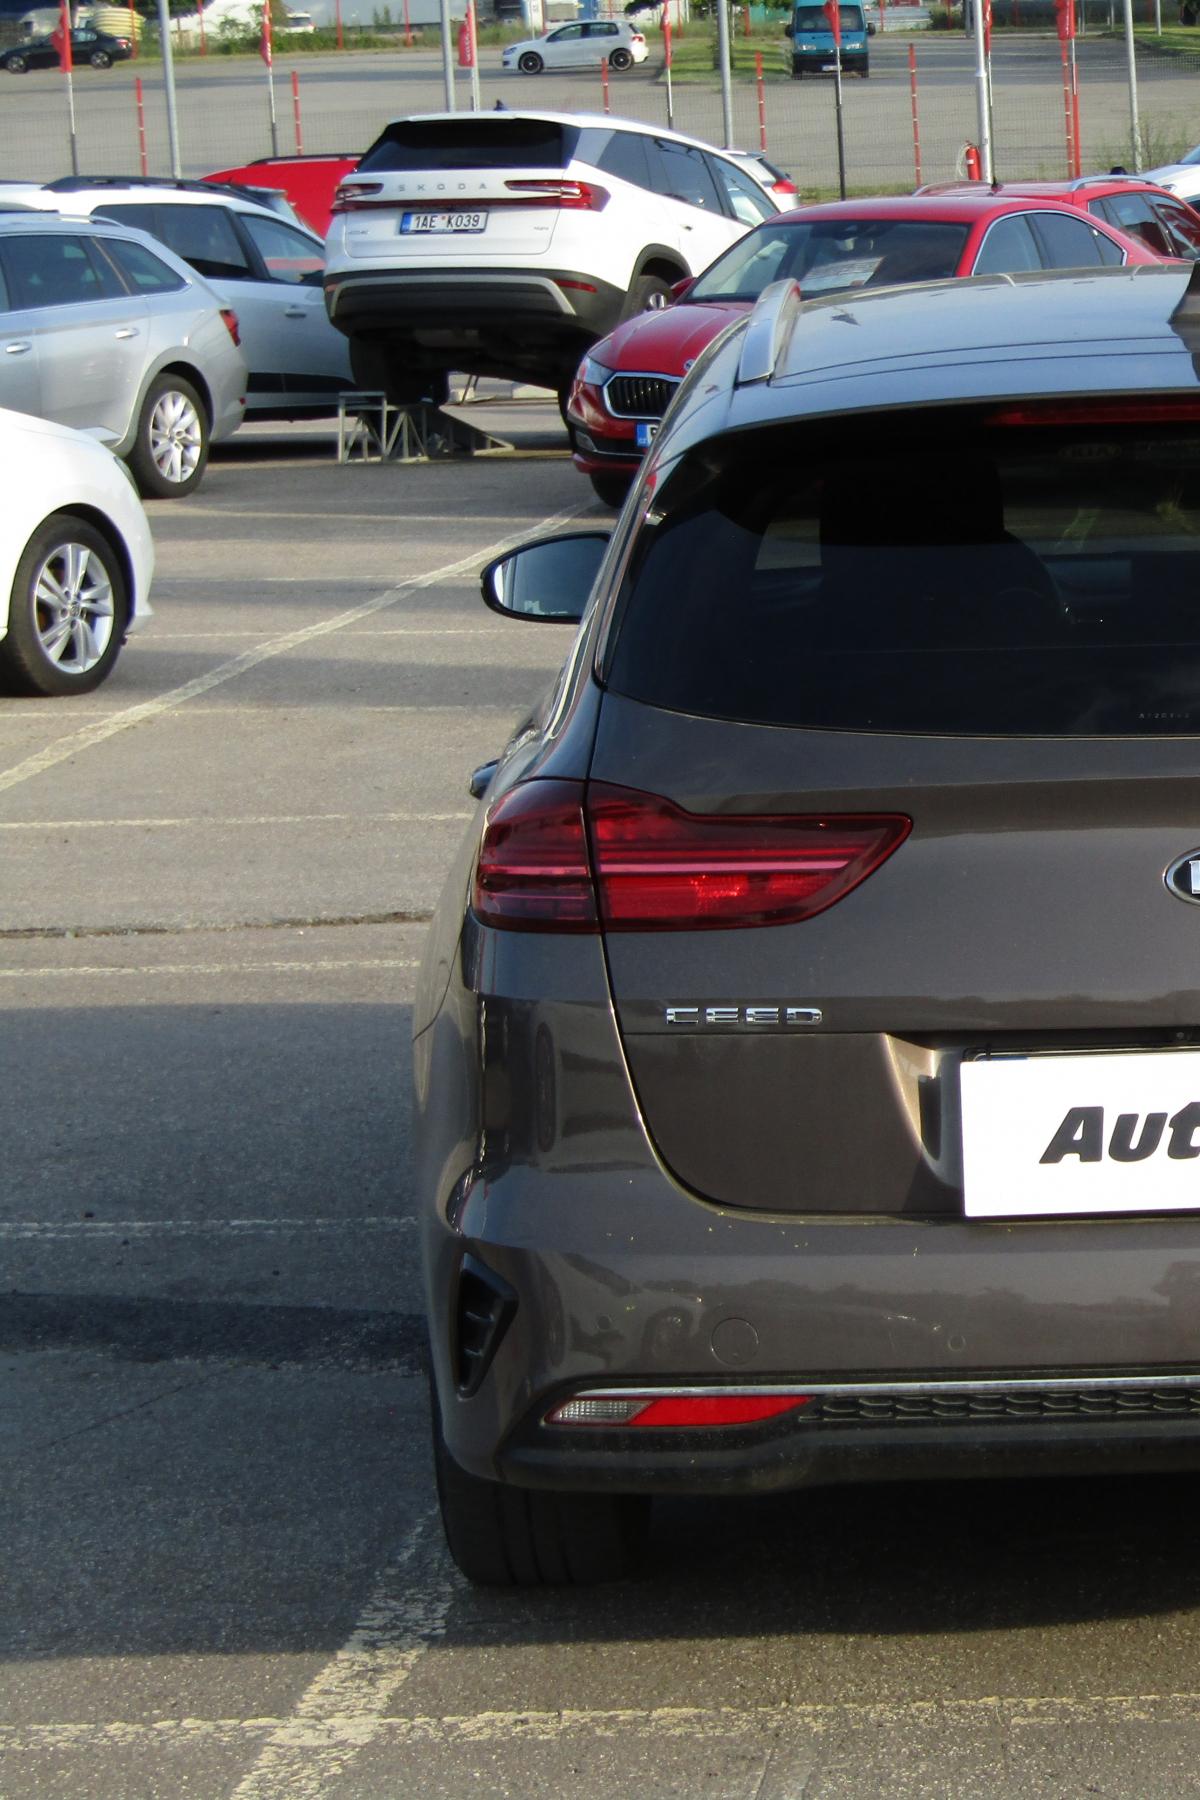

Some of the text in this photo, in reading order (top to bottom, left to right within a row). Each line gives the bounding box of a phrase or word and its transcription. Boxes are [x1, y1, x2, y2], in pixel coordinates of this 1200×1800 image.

[415, 214, 480, 229] 1AE K039
[666, 1007, 823, 1025] CEED
